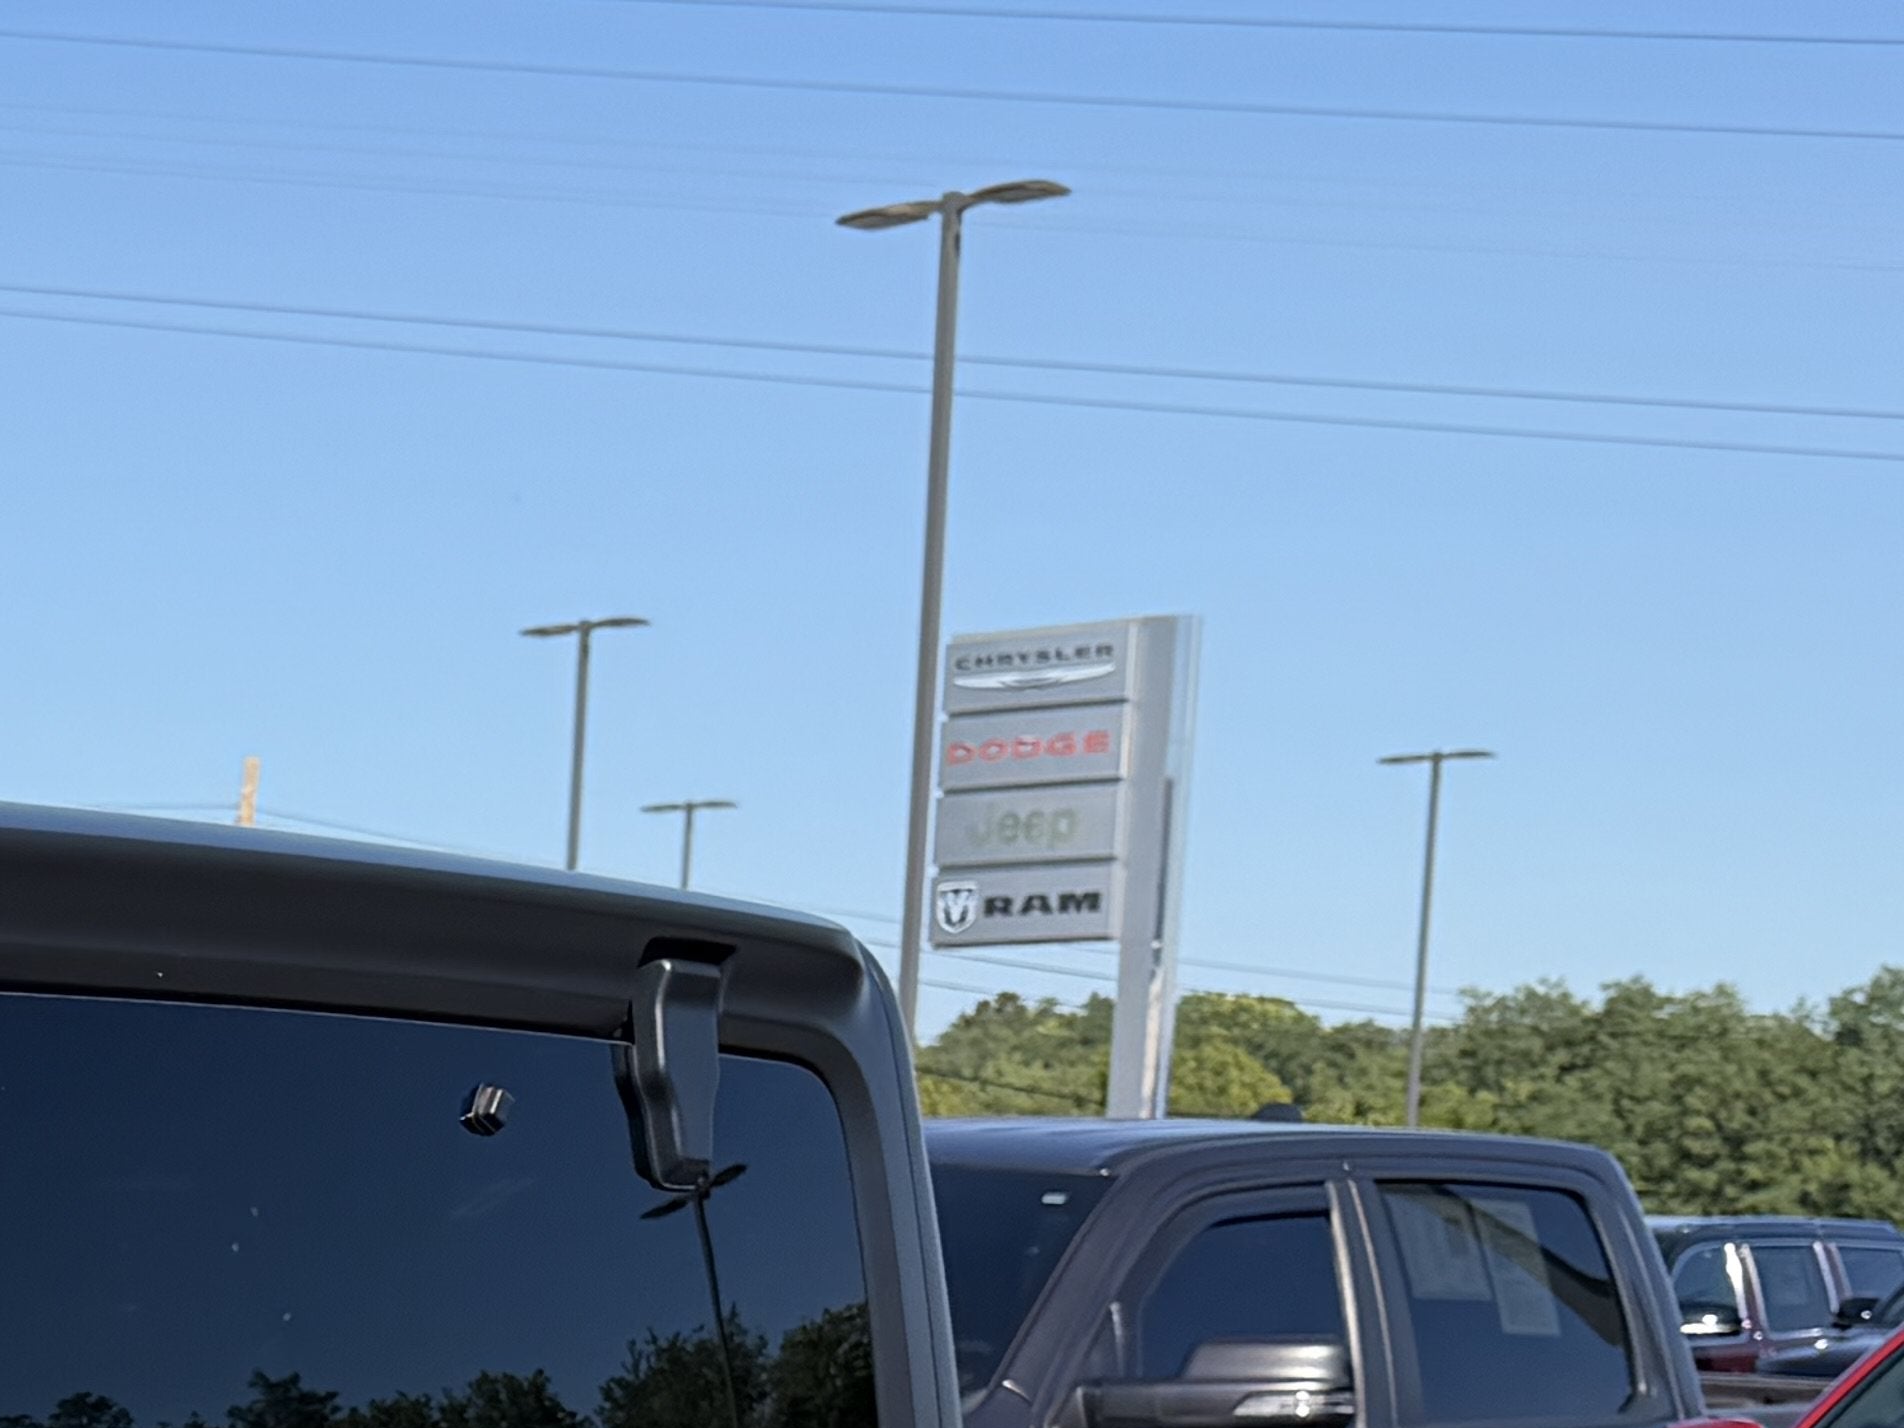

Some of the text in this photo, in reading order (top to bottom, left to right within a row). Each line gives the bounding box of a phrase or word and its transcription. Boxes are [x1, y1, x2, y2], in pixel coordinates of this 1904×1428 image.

[954, 643, 1115, 672] CHRYSLER
[946, 730, 1112, 766] DODGE
[967, 803, 1083, 850] Jeep
[983, 890, 1102, 918] RAM
